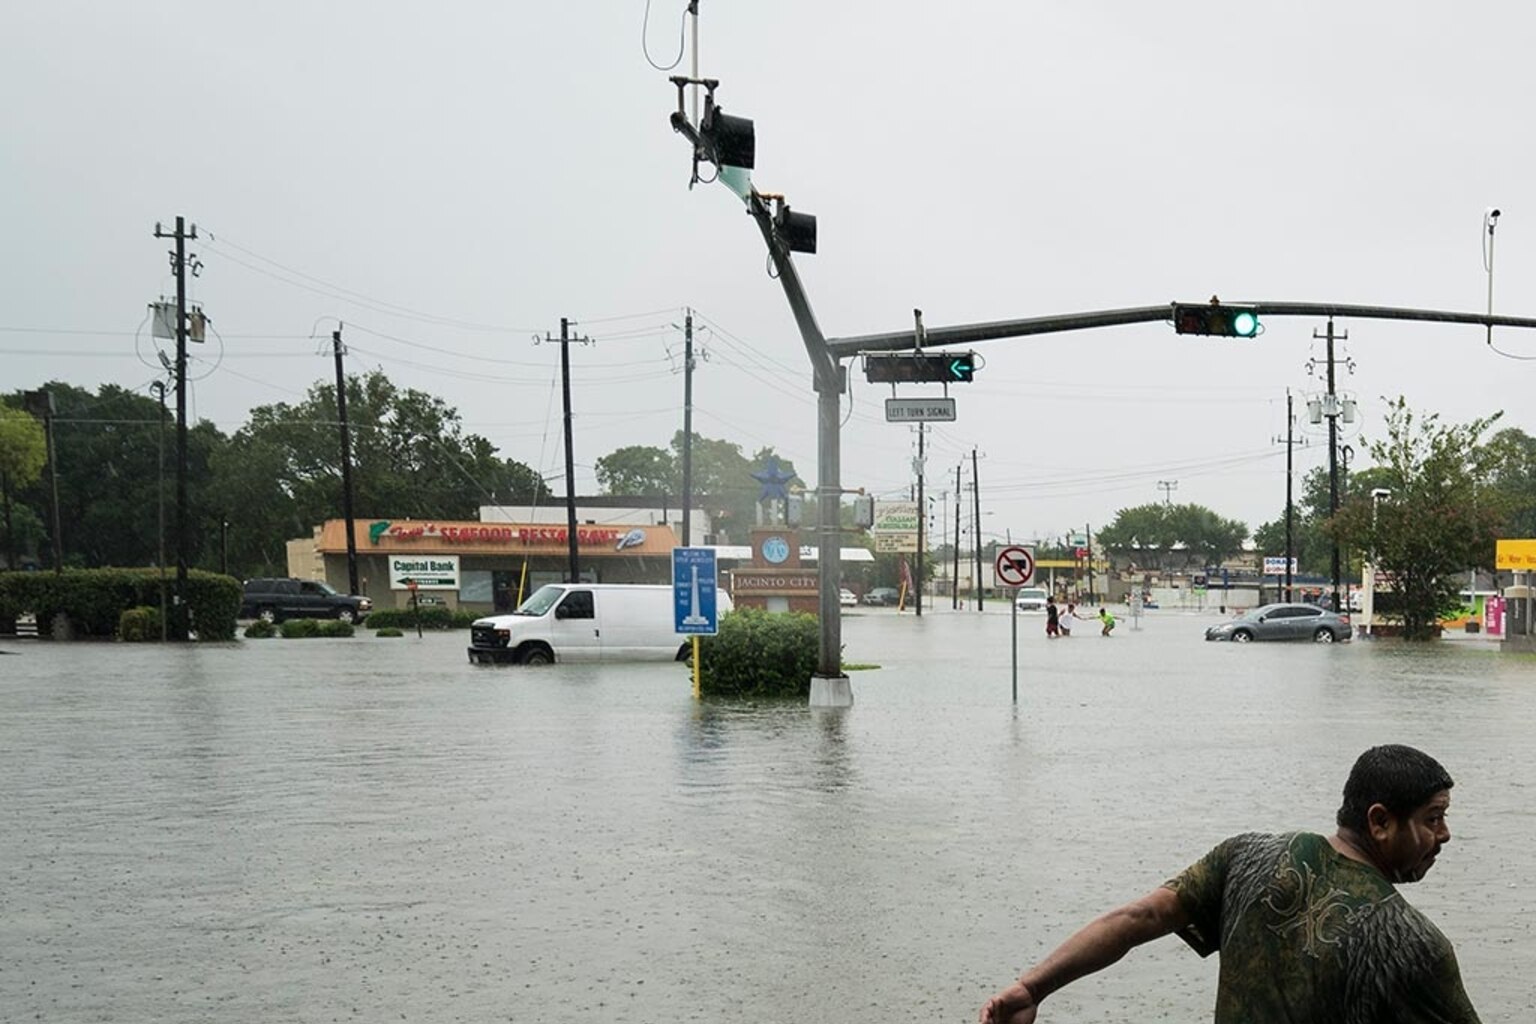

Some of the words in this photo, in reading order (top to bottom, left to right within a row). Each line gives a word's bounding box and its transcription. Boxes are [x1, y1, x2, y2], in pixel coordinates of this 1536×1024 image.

[889, 407, 904, 418] LEFT
[907, 407, 924, 418] TURN
[927, 407, 951, 417] SIGNAL
[440, 527, 512, 542] SEAFOOD
[519, 528, 620, 543] RESTARANT
[394, 560, 428, 572] Capital
[430, 561, 454, 571] Bank
[737, 577, 785, 588] JACINTO
[789, 577, 817, 587] CITY
